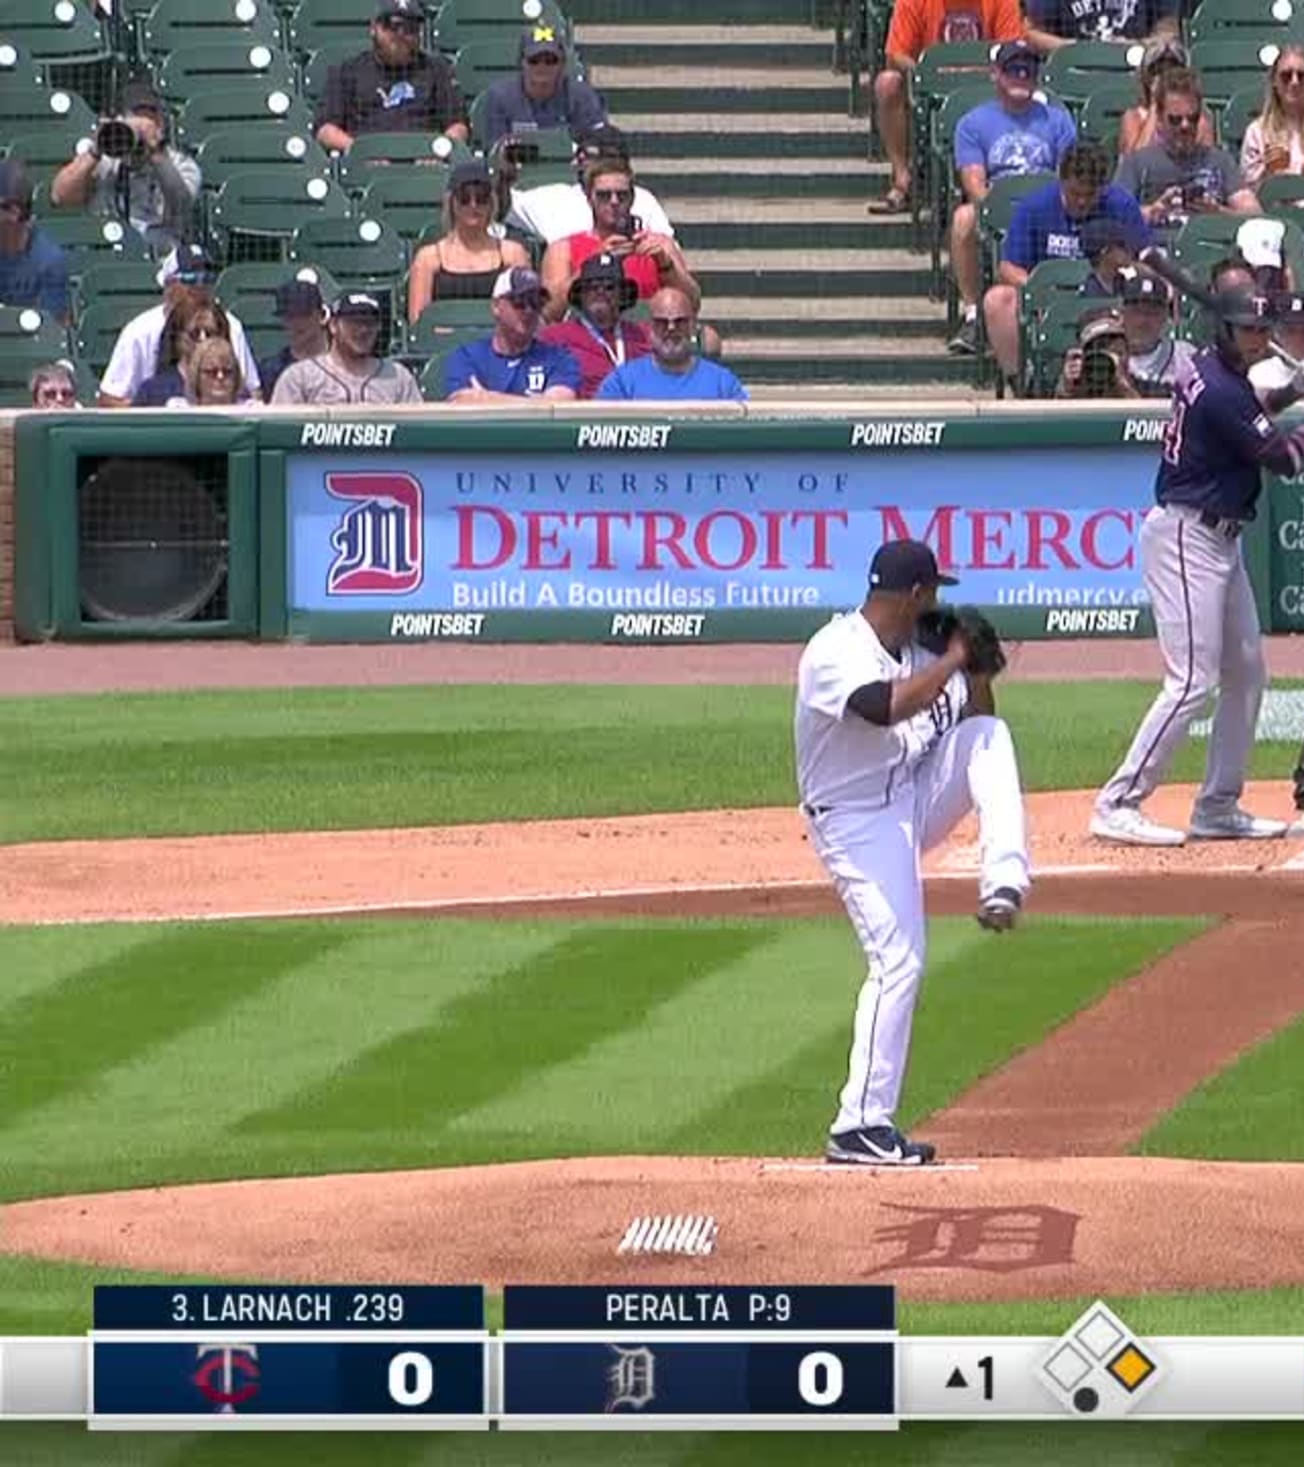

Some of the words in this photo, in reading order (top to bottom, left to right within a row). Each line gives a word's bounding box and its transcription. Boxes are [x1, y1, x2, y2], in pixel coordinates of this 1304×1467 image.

[301, 423, 396, 446] POINTSBET
[578, 425, 671, 447] POINTSBET
[851, 422, 945, 445] POINTSBET
[456, 472, 760, 494] UNIVERSITY
[798, 472, 849, 494] OF
[448, 505, 848, 571] DETROIT
[872, 505, 1148, 571] MERC
[453, 582, 525, 607] Build
[536, 584, 558, 607] A
[568, 582, 715, 607] Boundless
[726, 583, 819, 606] Future
[997, 581, 1150, 606] udmercy.e
[391, 613, 484, 636] POINTSBET
[611, 614, 705, 636] POINTSBET
[1046, 610, 1140, 633] POINTSBET
